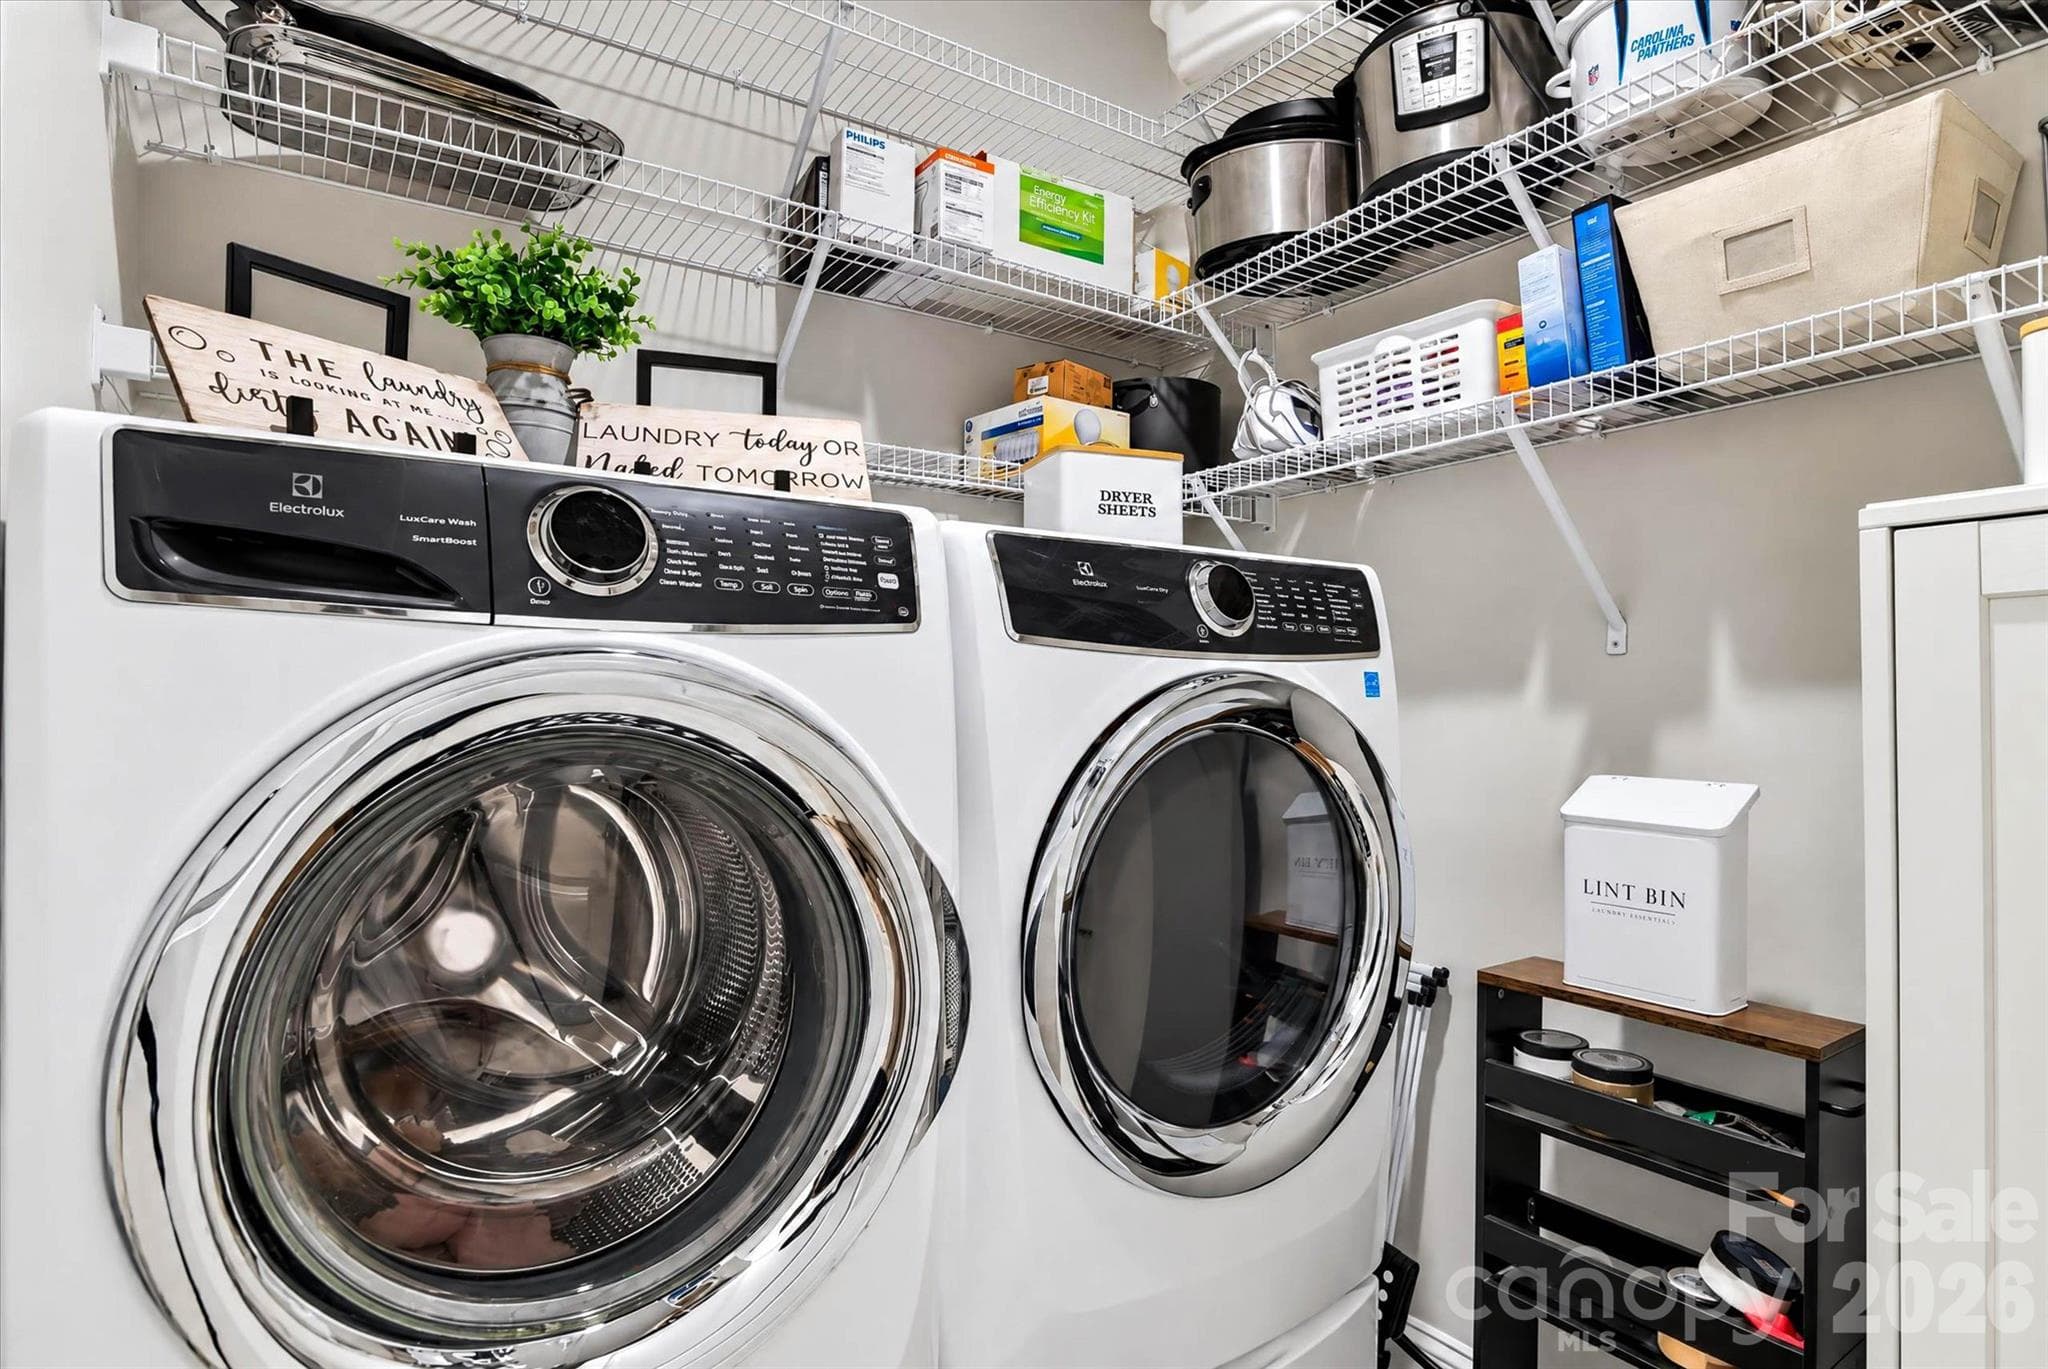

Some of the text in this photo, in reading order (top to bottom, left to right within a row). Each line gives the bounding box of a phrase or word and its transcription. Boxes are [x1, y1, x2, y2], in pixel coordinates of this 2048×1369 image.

[1631, 24, 1684, 52] CAROLINA
[1637, 33, 1696, 62] PANTHERS
[846, 130, 886, 150] PHILIPS
[1033, 185, 1066, 206] Energy
[1029, 195, 1080, 222] Efficiency
[1082, 209, 1096, 225] Kit
[250, 338, 484, 425] THE laundry
[260, 368, 279, 380] IS
[290, 376, 371, 402] LOOKING
[383, 398, 401, 409] AT
[583, 422, 861, 467] LAUNDRY today OR
[1100, 488, 1154, 505] DRYER
[269, 502, 345, 518] Electrolux
[399, 514, 477, 527] LuxCare Wash
[1097, 503, 1157, 518] SHEETS
[411, 534, 478, 546] SmartBoost
[1072, 578, 1108, 588] Electrolux
[1583, 878, 1686, 909] LINT BIN
